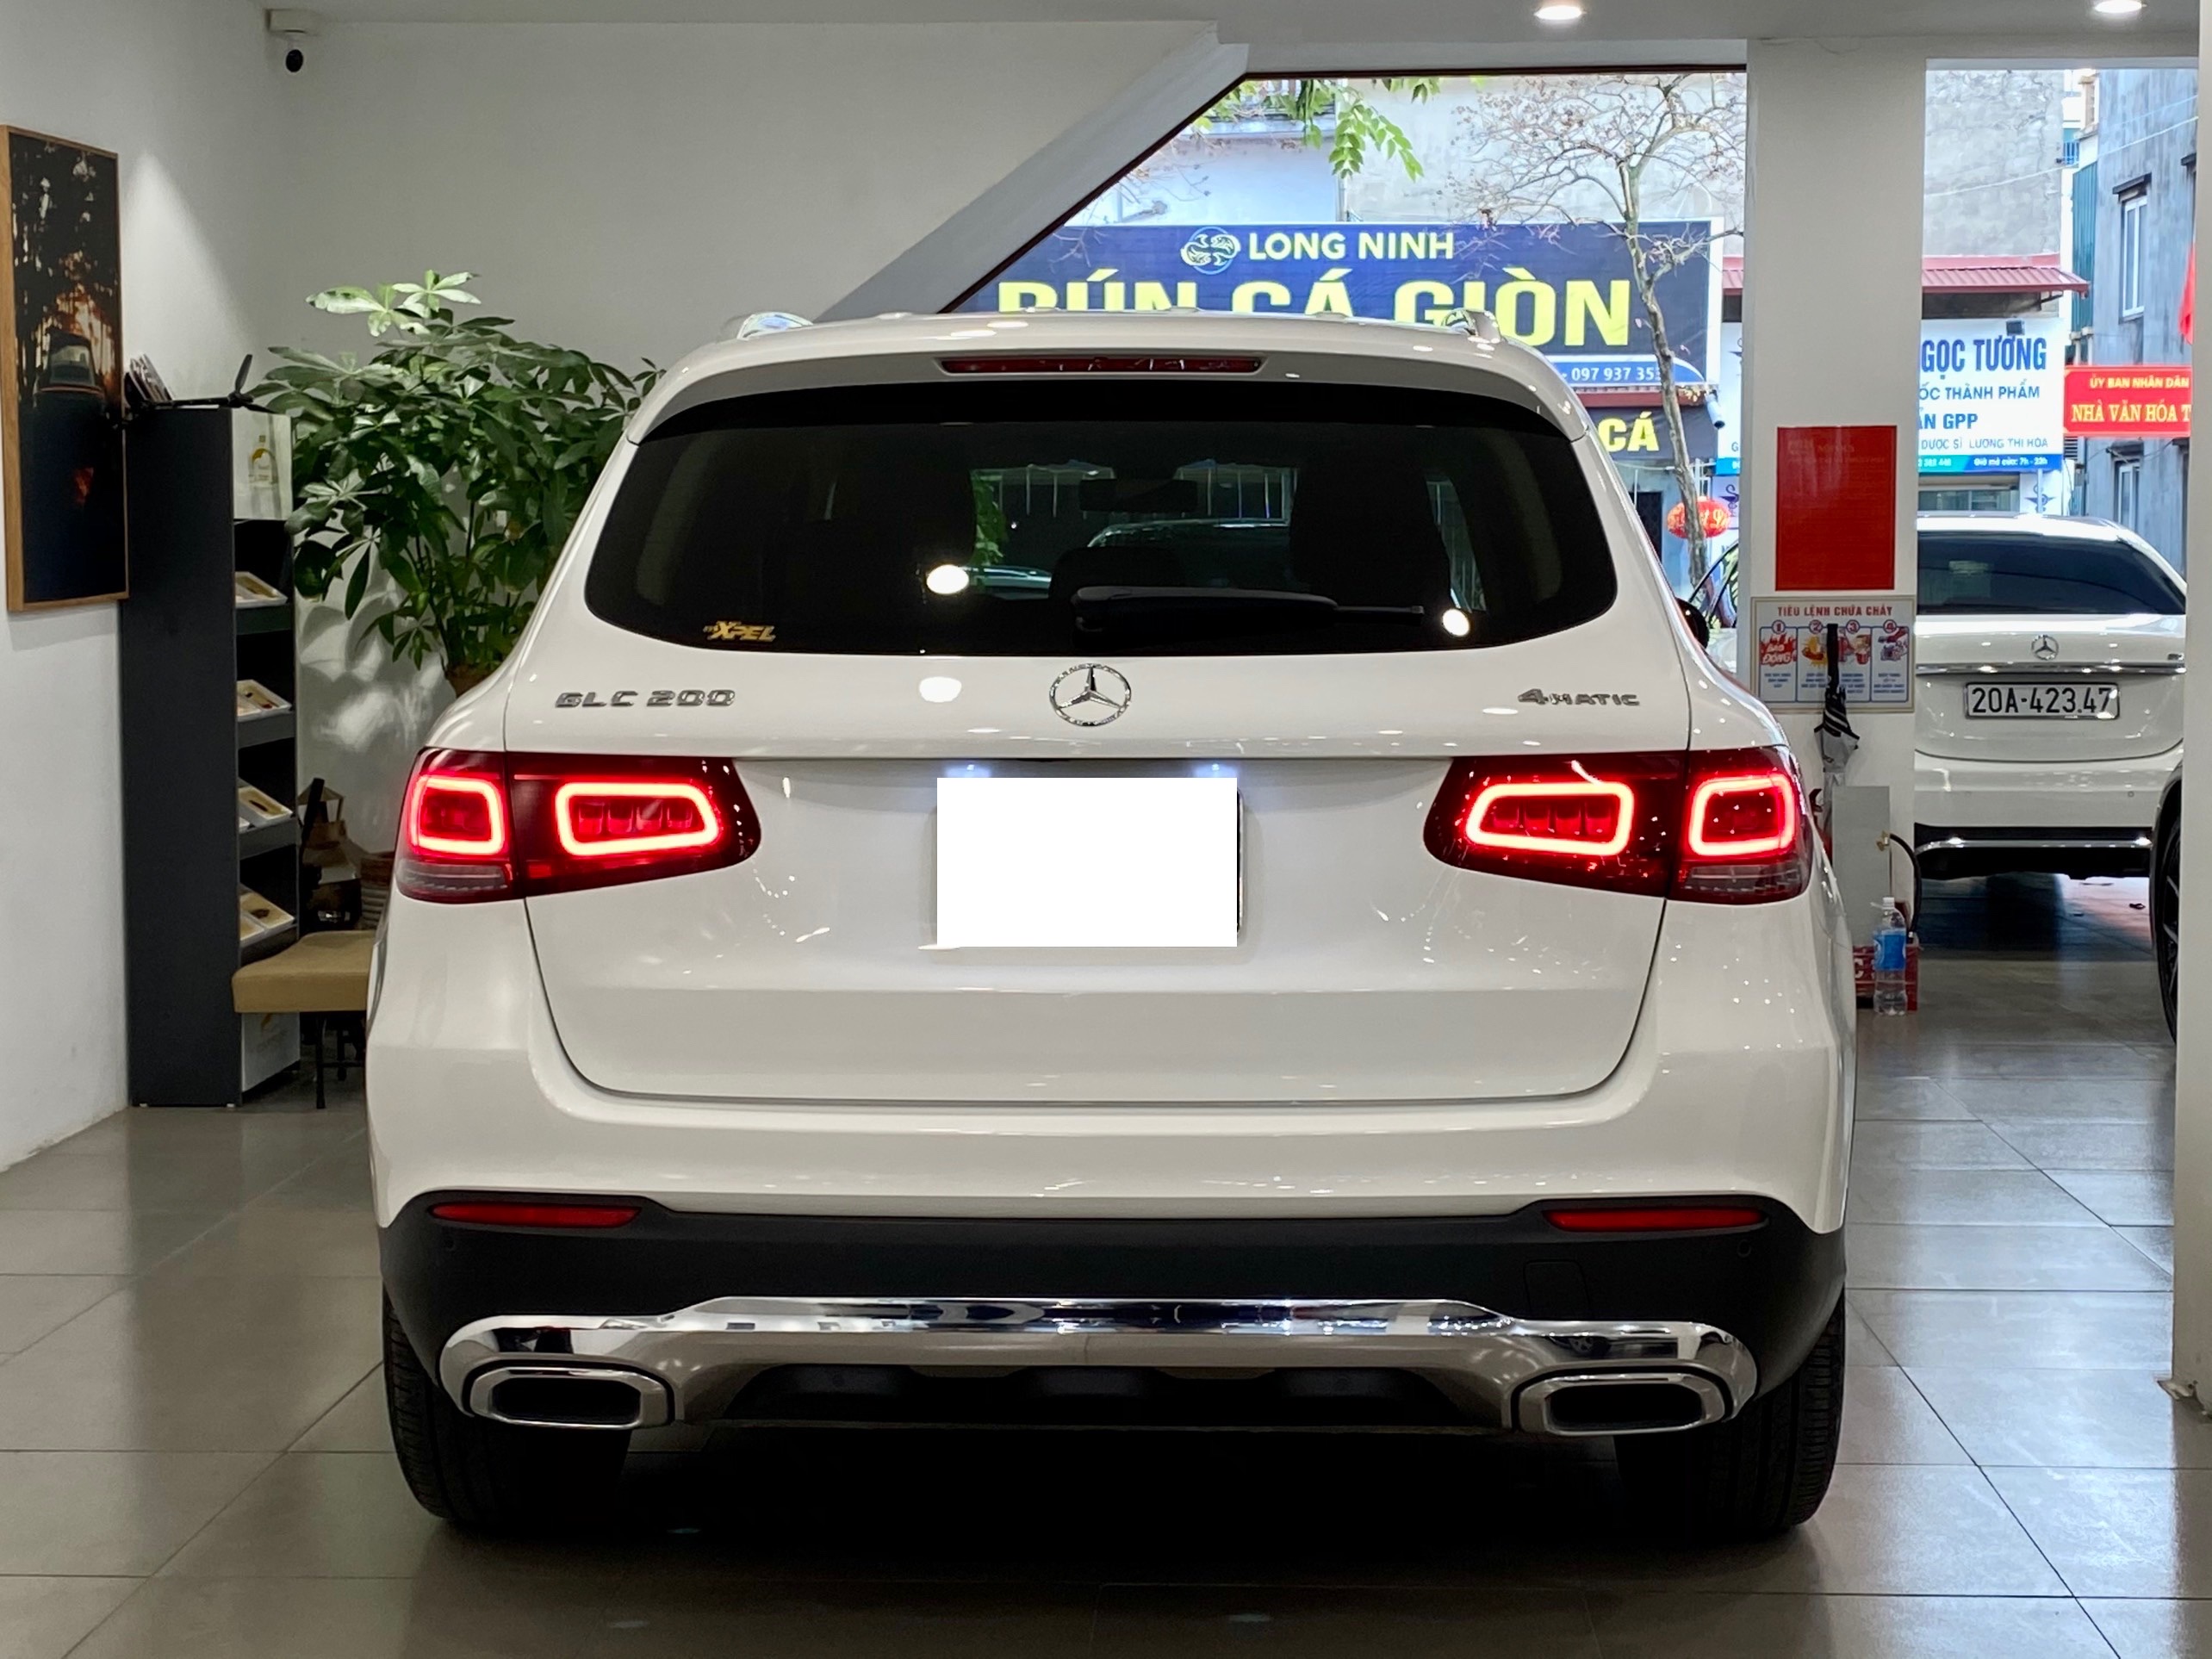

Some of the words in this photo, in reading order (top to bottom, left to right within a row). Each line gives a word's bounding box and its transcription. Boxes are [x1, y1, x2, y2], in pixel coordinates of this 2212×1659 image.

[1248, 233, 1345, 259] LONG
[1358, 232, 1454, 259] NINH
[1394, 267, 1631, 346] GIÒN
[1571, 367, 1600, 381] 097
[1603, 367, 1631, 381] 937
[2108, 377, 2130, 388] BAN
[2132, 375, 2163, 388] NHÂN
[1942, 413, 1979, 429] GPP
[2071, 399, 2104, 422] NHÀ
[2109, 399, 2141, 422] VĂN
[2144, 398, 2178, 422] HÓA
[1598, 411, 1660, 452] CÁ
[706, 620, 775, 642] XPEL
[555, 690, 638, 708] GLC
[646, 689, 736, 707] 200
[1517, 688, 1640, 705] 4MATIC
[1972, 687, 2112, 714] 20A-423.47
